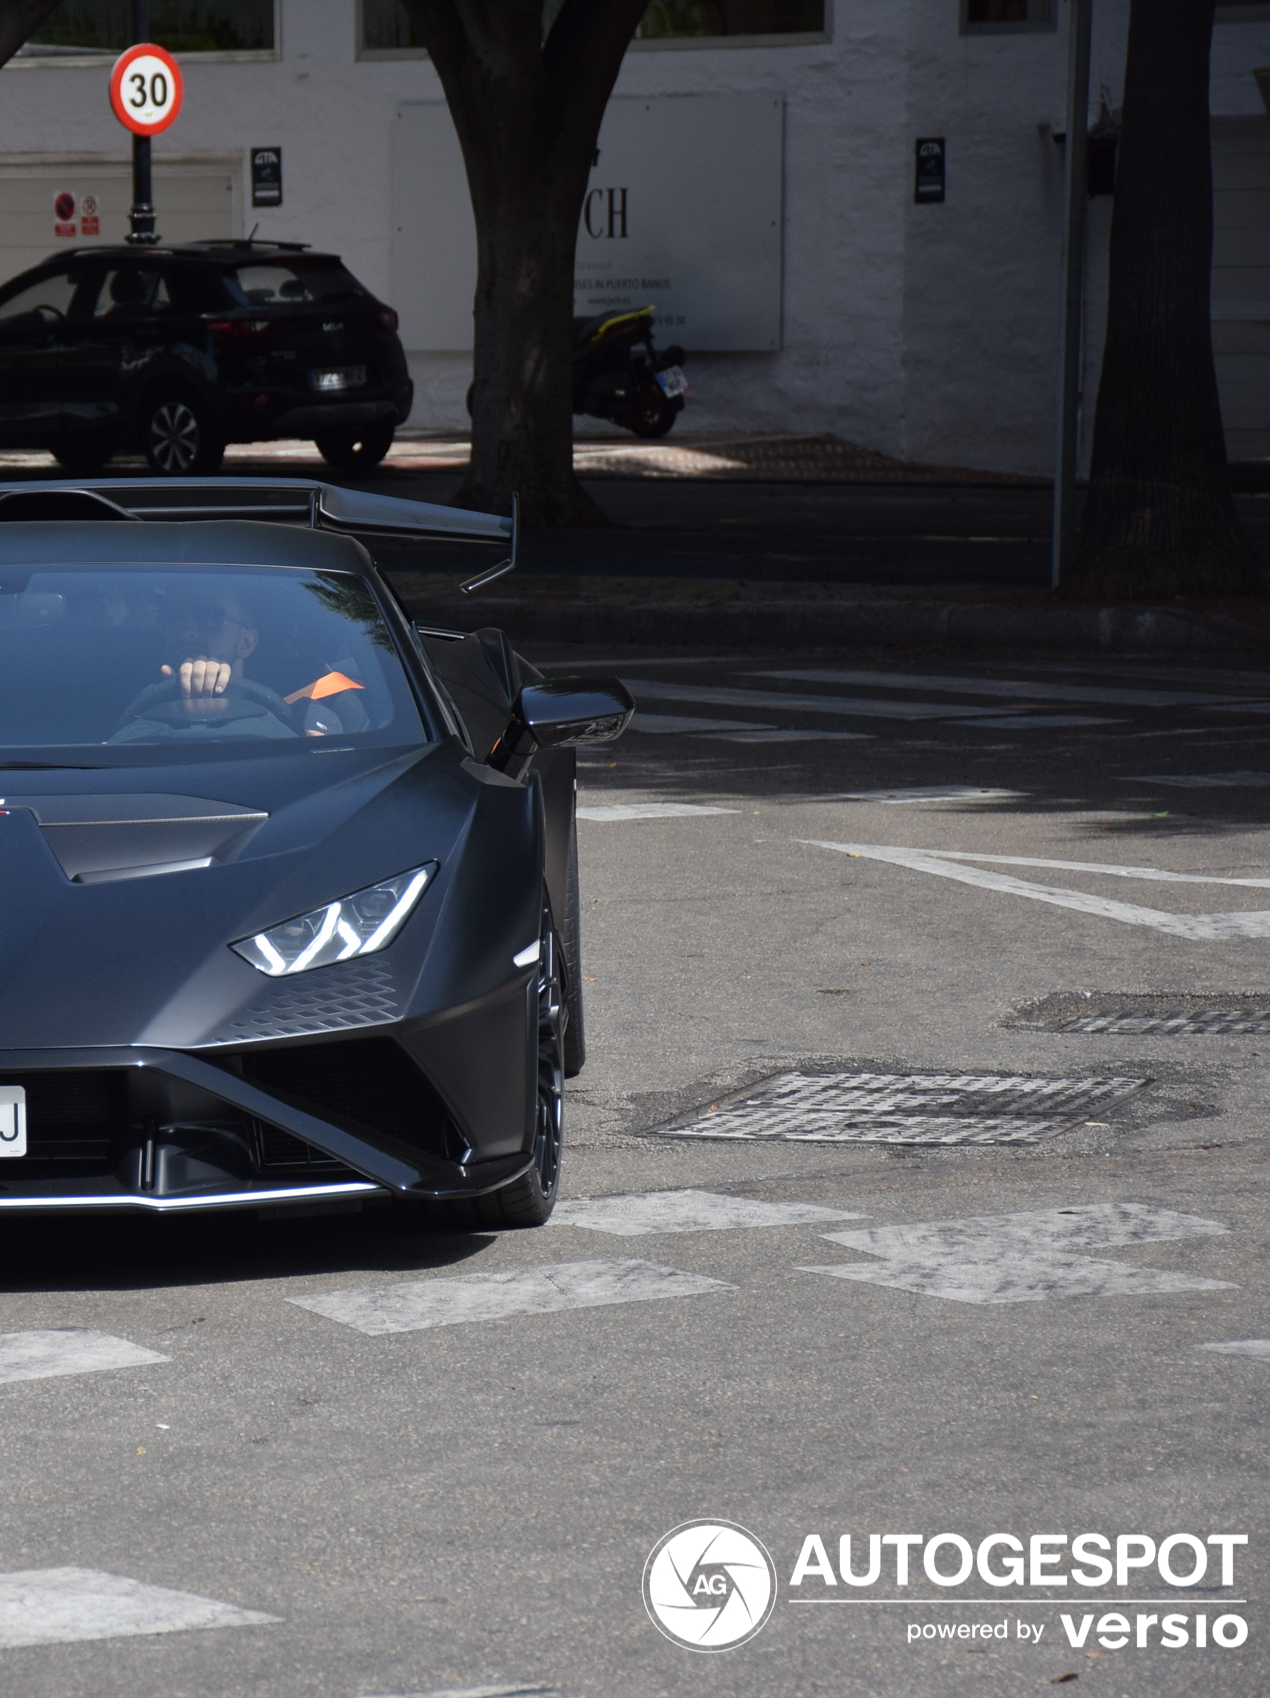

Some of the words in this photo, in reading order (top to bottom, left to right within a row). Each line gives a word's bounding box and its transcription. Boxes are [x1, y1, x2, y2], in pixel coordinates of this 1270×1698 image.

[129, 73, 167, 107] 30
[255, 151, 278, 165] GTA
[584, 187, 629, 239] CH
[594, 278, 605, 290] IN
[606, 278, 639, 290] PUERTO
[640, 278, 671, 290] BANUS
